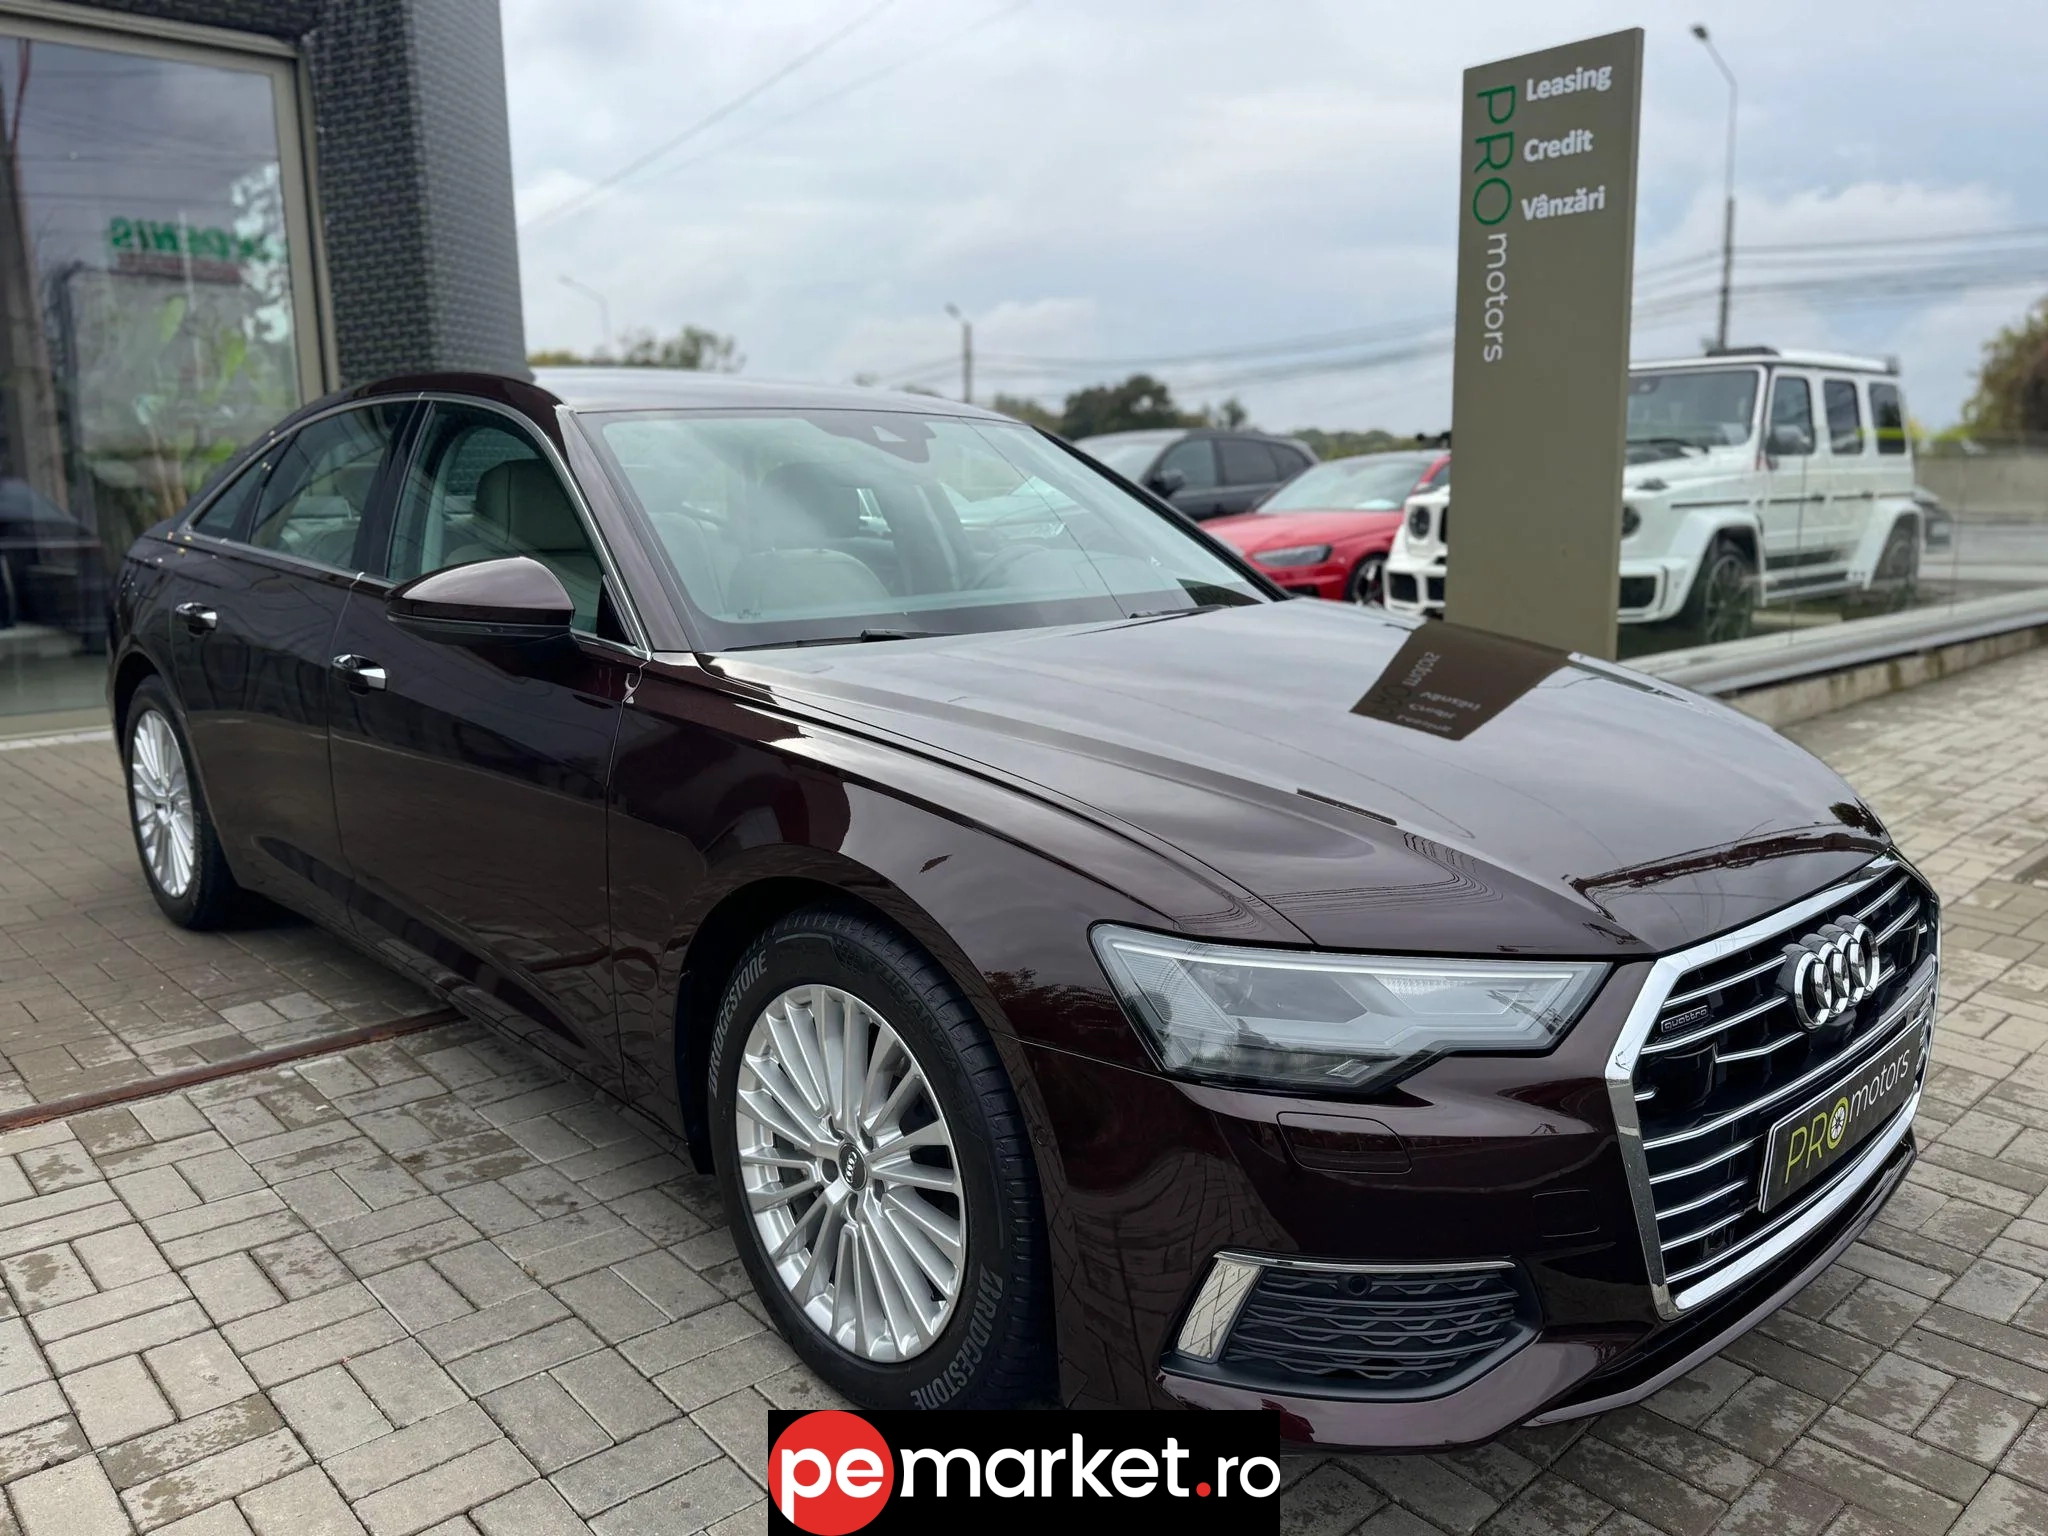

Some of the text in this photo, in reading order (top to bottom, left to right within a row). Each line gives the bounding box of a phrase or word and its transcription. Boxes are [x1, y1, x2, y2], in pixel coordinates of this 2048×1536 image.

[1526, 66, 1612, 101] Leasing
[1523, 129, 1593, 161] Credit
[1521, 186, 1605, 220] Vânzări
[708, 949, 768, 1098] BRIDGESTONE
[1664, 1009, 1707, 1030] quattro
[910, 1262, 1003, 1411] BRIDGESTONE
